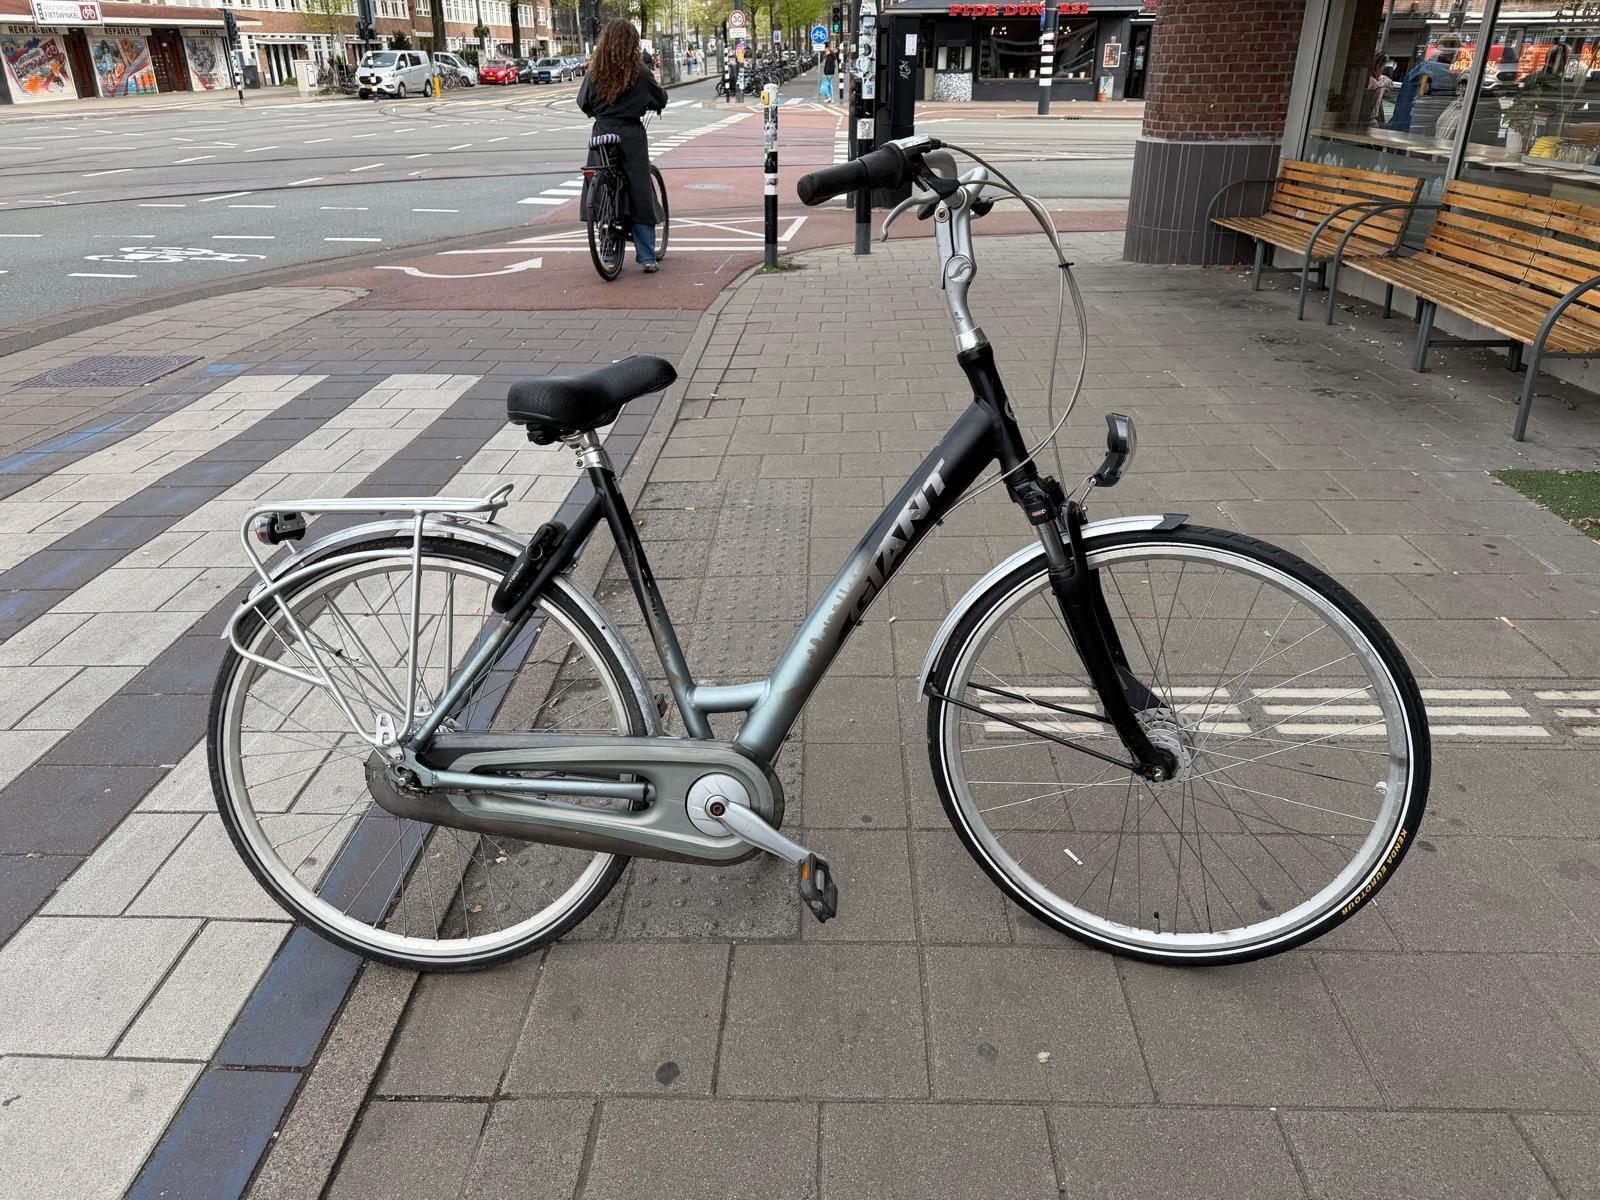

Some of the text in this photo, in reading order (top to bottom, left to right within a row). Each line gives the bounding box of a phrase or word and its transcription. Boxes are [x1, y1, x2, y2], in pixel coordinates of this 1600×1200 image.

[949, 1, 1089, 16] PIDE DÜNASI
[733, 15, 742, 23] 30
[104, 27, 141, 36] REPARATIE
[1386, 828, 1409, 866] KENDA
[1341, 865, 1388, 916] EUROTOUR
